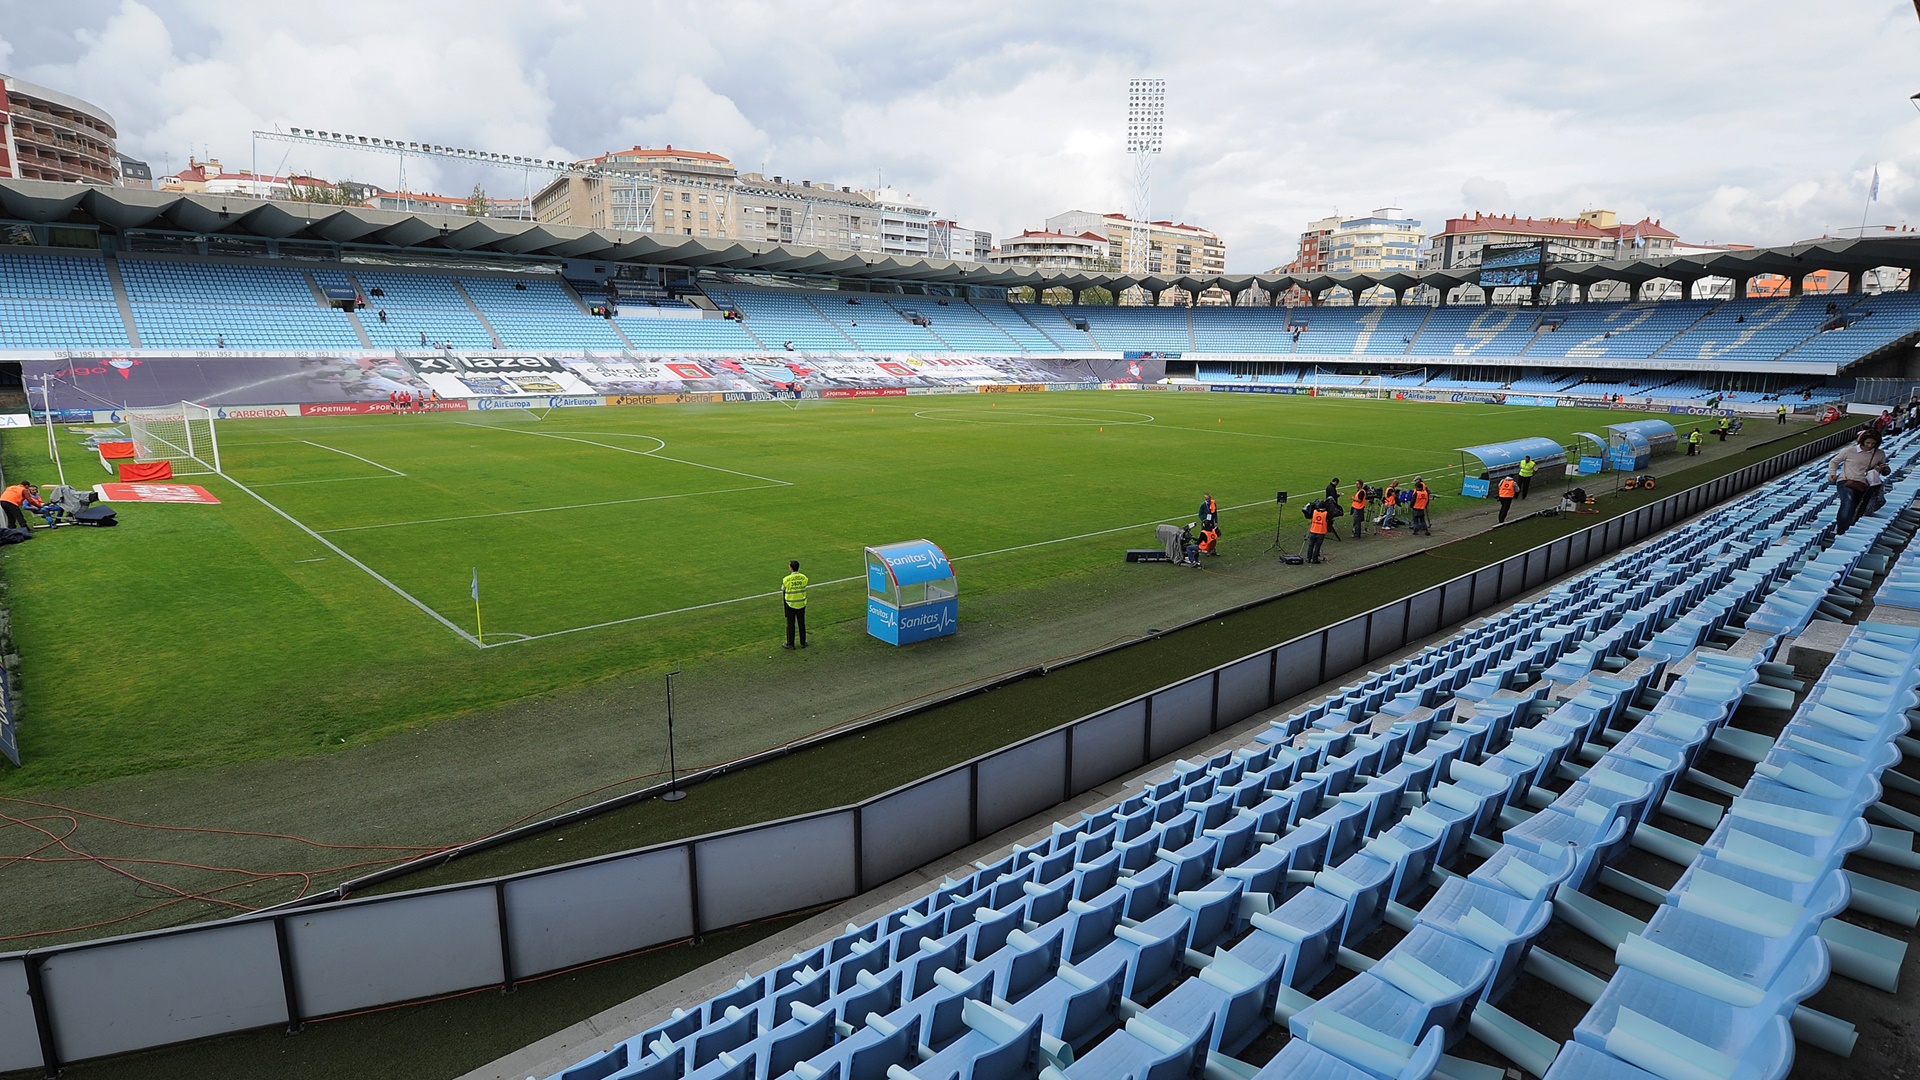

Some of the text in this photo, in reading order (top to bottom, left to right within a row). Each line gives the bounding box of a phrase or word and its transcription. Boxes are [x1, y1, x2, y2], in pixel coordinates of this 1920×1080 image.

[990, 385, 1008, 393] betfair
[684, 394, 714, 403] betfair
[725, 393, 746, 401] BBVA
[777, 391, 796, 400] BBVA
[801, 390, 819, 399] BBVA
[564, 399, 597, 407] AirEuropa
[625, 395, 658, 405] betfair
[494, 401, 531, 409] AirEuropa
[1688, 408, 1727, 416] OCASO
[885, 553, 927, 567] Sanitas
[869, 604, 889, 619] Sanitas
[900, 613, 939, 630] Sanitas
